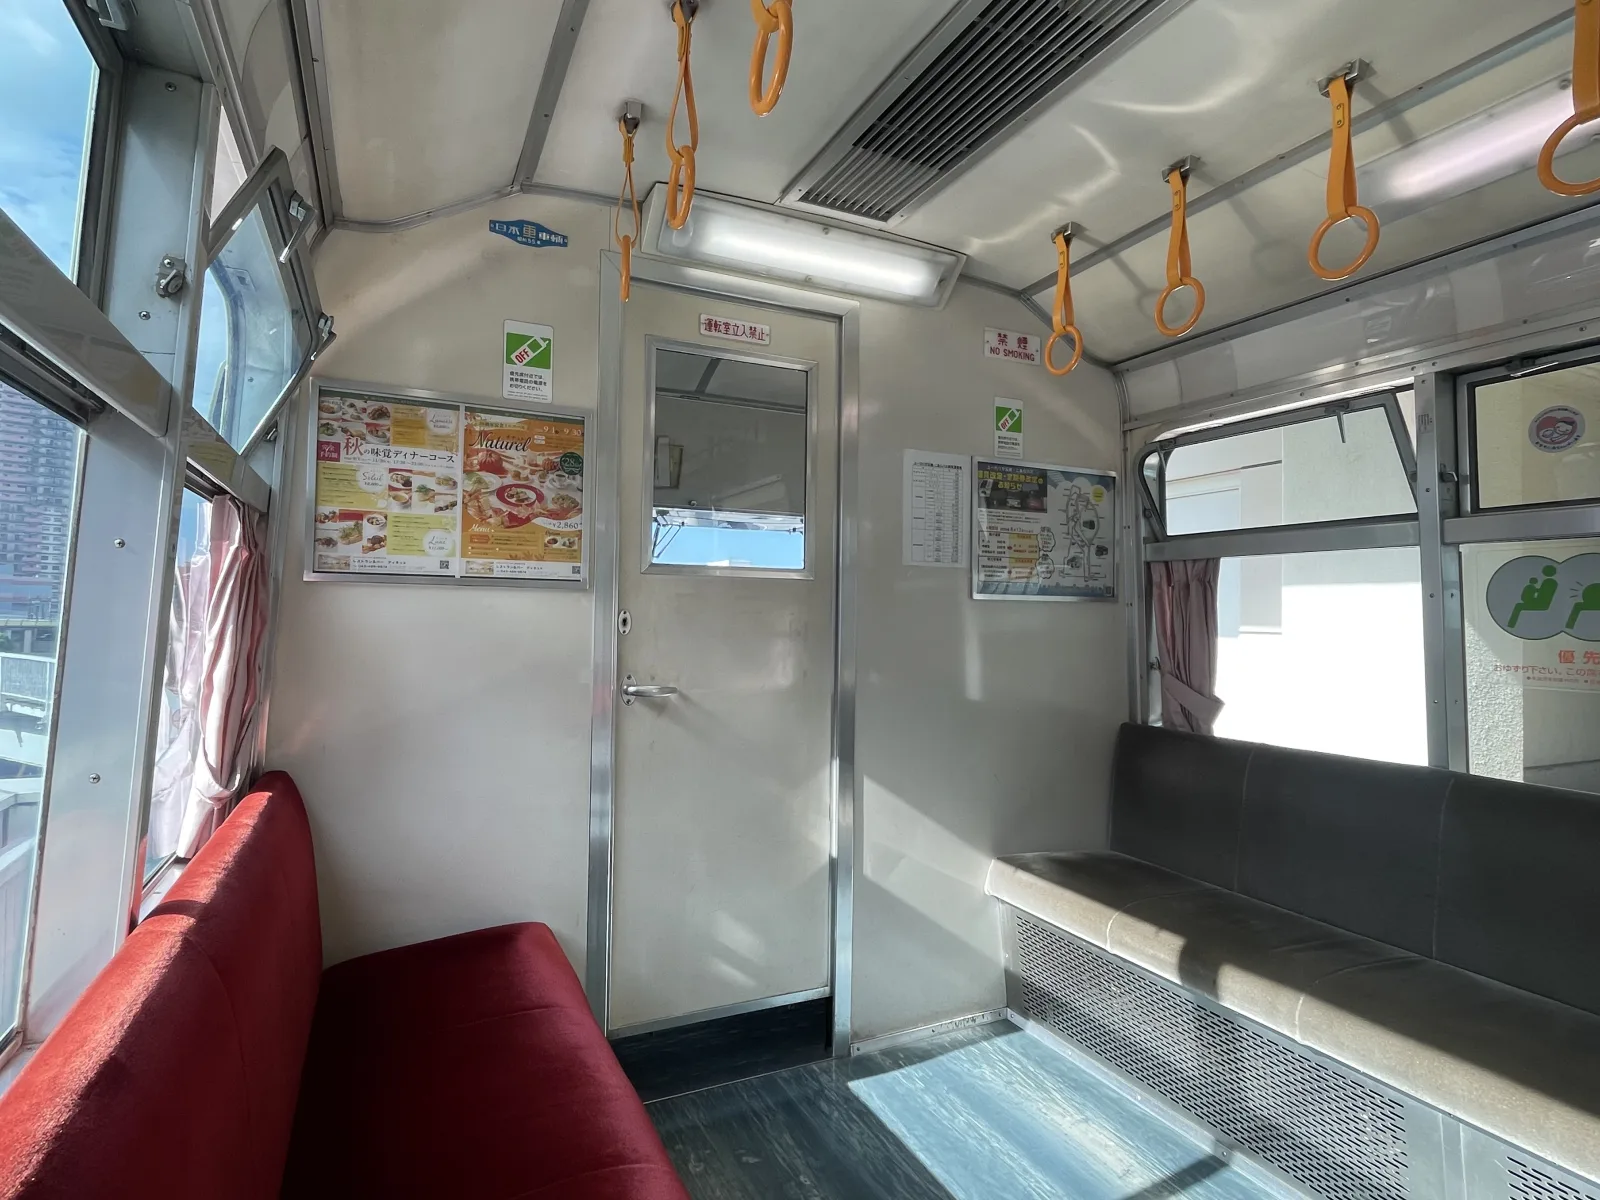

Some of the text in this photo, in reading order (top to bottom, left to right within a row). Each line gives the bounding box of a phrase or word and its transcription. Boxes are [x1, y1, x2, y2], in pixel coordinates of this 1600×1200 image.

[704, 318, 766, 341] 運転室立入禁止
[514, 348, 530, 364] OFF
[990, 346, 1035, 362] NO SMOKING
[1000, 417, 1010, 430] OFF
[342, 435, 455, 463] 秋の味覚ディナーコース
[469, 430, 532, 452] Naturel
[998, 481, 1022, 490] お知らせ
[552, 522, 578, 530] ¥2,860
[1493, 664, 1600, 677] おゆずり下さい。この席
